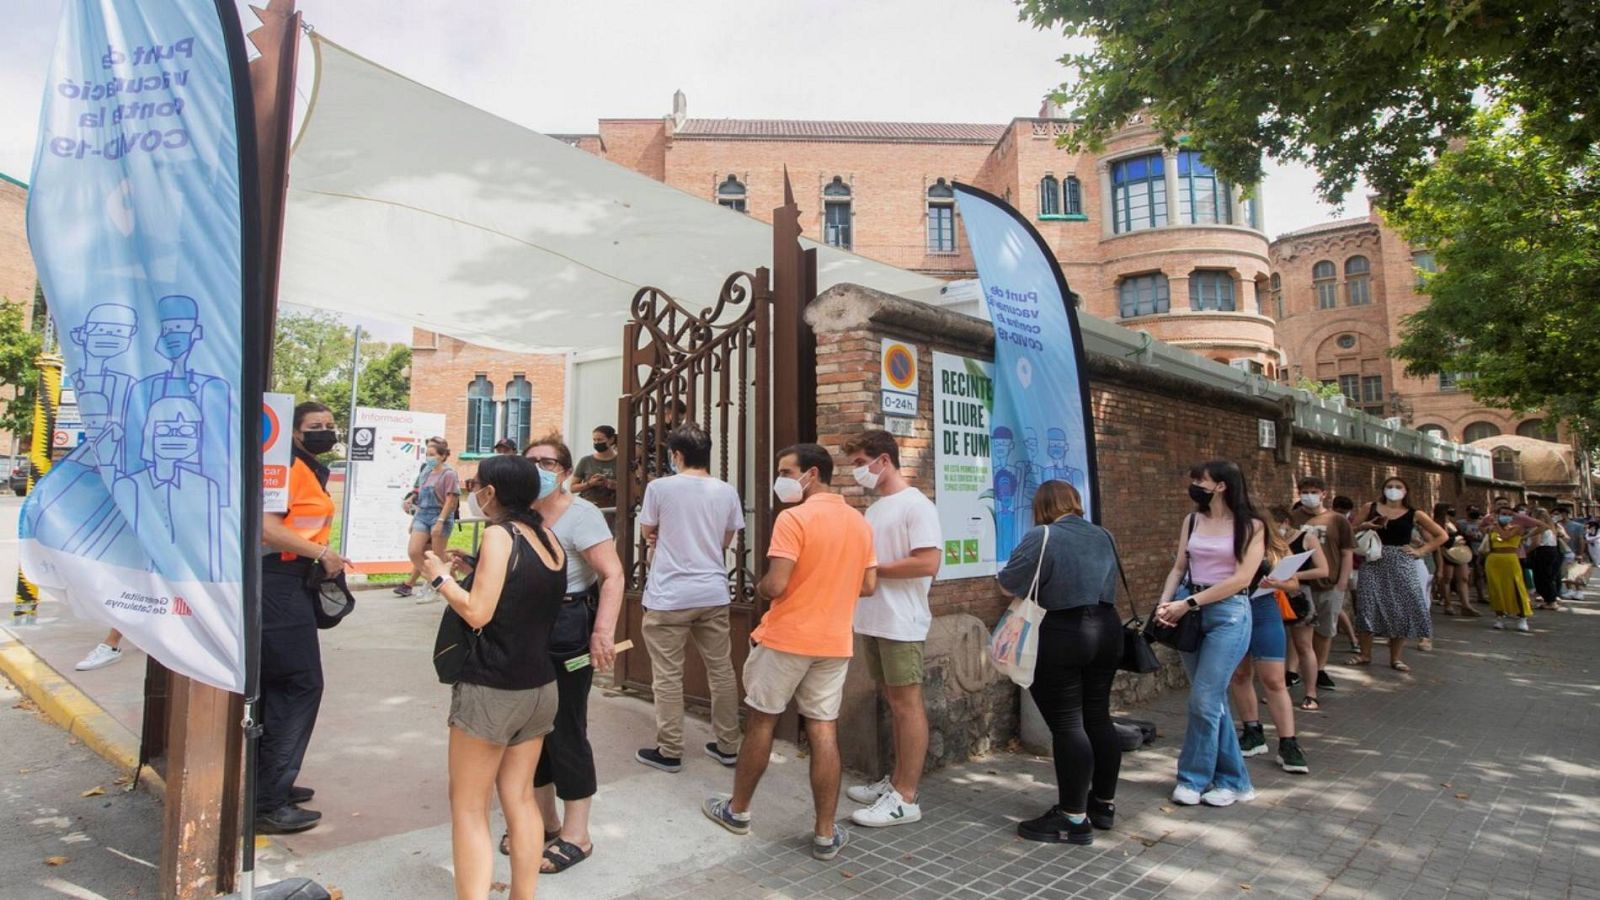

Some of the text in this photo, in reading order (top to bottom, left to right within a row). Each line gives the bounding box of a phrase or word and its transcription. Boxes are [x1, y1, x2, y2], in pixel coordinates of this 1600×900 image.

[941, 368, 993, 402] RECINTE
[361, 411, 413, 424] Informació
[942, 399, 985, 428] LLIURE
[943, 430, 990, 458] DE FUM
